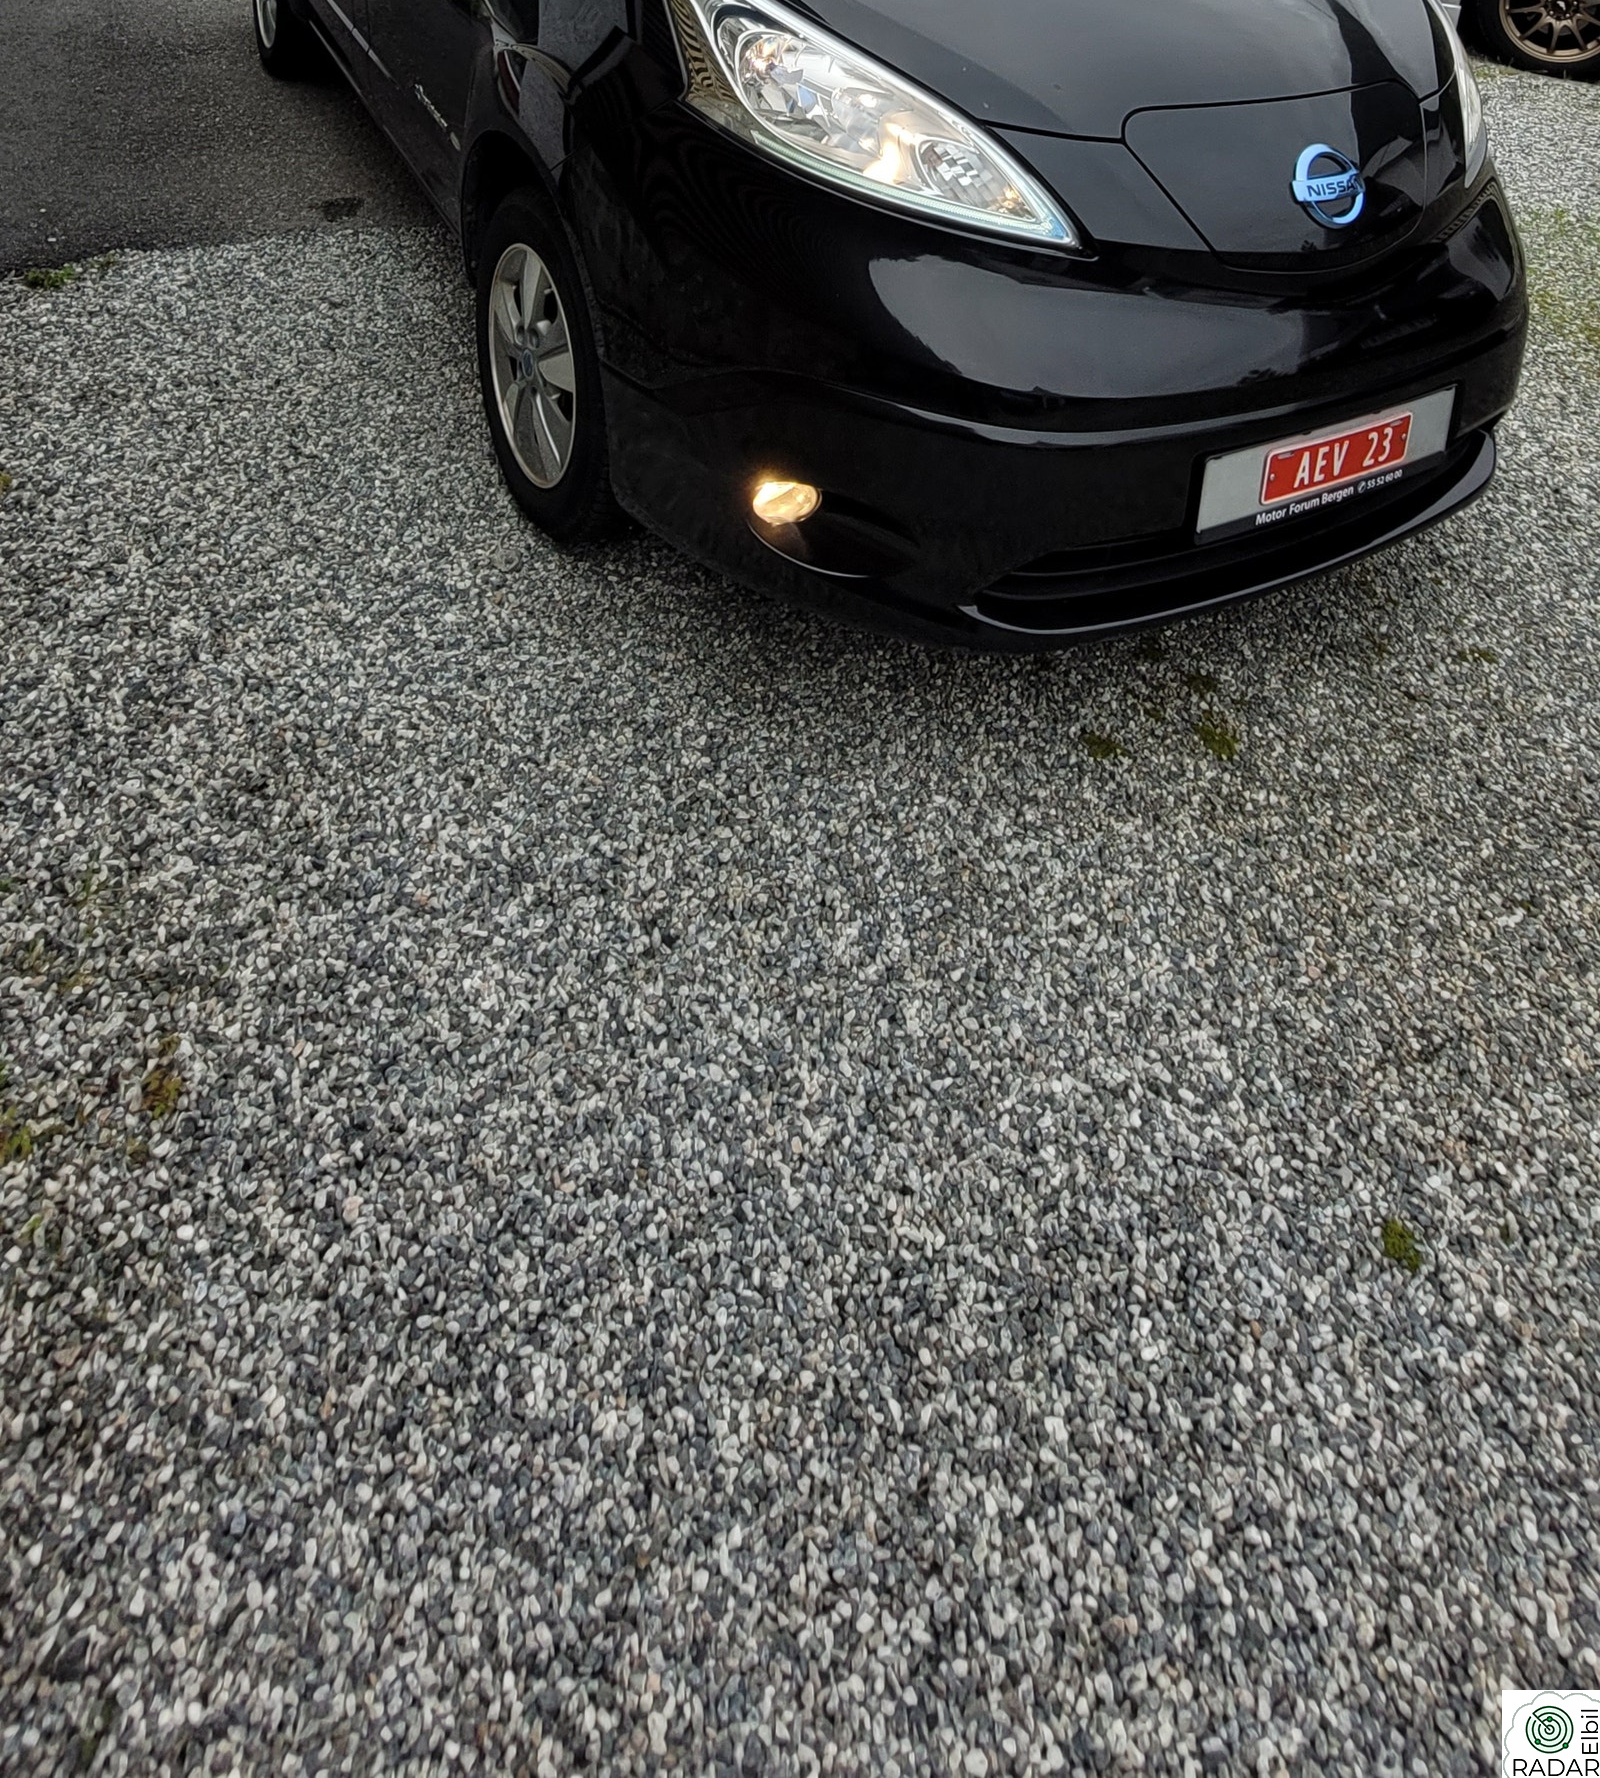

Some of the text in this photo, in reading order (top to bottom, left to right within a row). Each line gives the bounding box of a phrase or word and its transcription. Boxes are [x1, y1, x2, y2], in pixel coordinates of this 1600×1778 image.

[1293, 427, 1393, 489] AEV 23
[1256, 509, 1287, 525] Motor
[1289, 498, 1320, 515] Forum
[1321, 486, 1354, 504] Bergen
